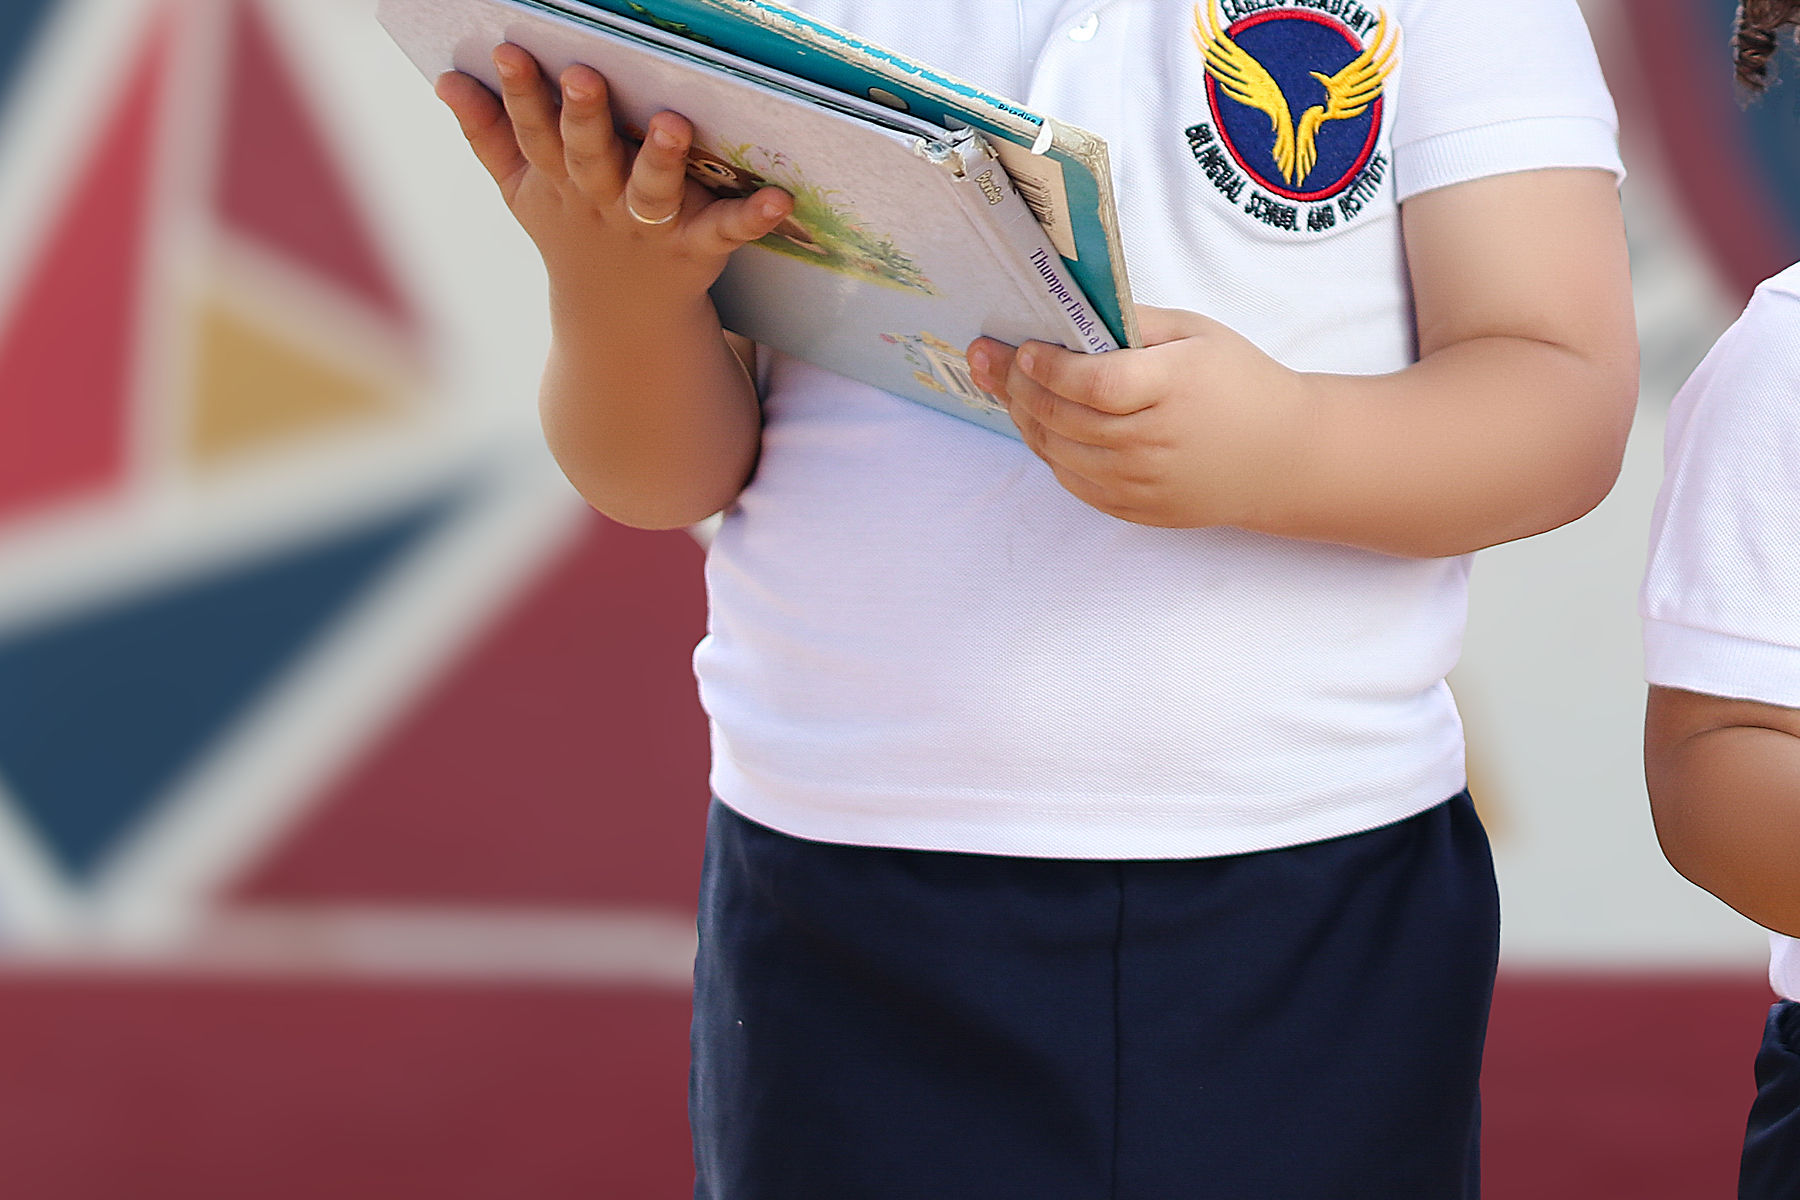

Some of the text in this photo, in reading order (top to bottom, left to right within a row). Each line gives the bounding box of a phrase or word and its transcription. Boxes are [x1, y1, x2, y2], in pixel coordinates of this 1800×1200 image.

[1029, 247, 1074, 305] Thumper
[1066, 301, 1095, 337] Finds
[1088, 336, 1100, 346] a
